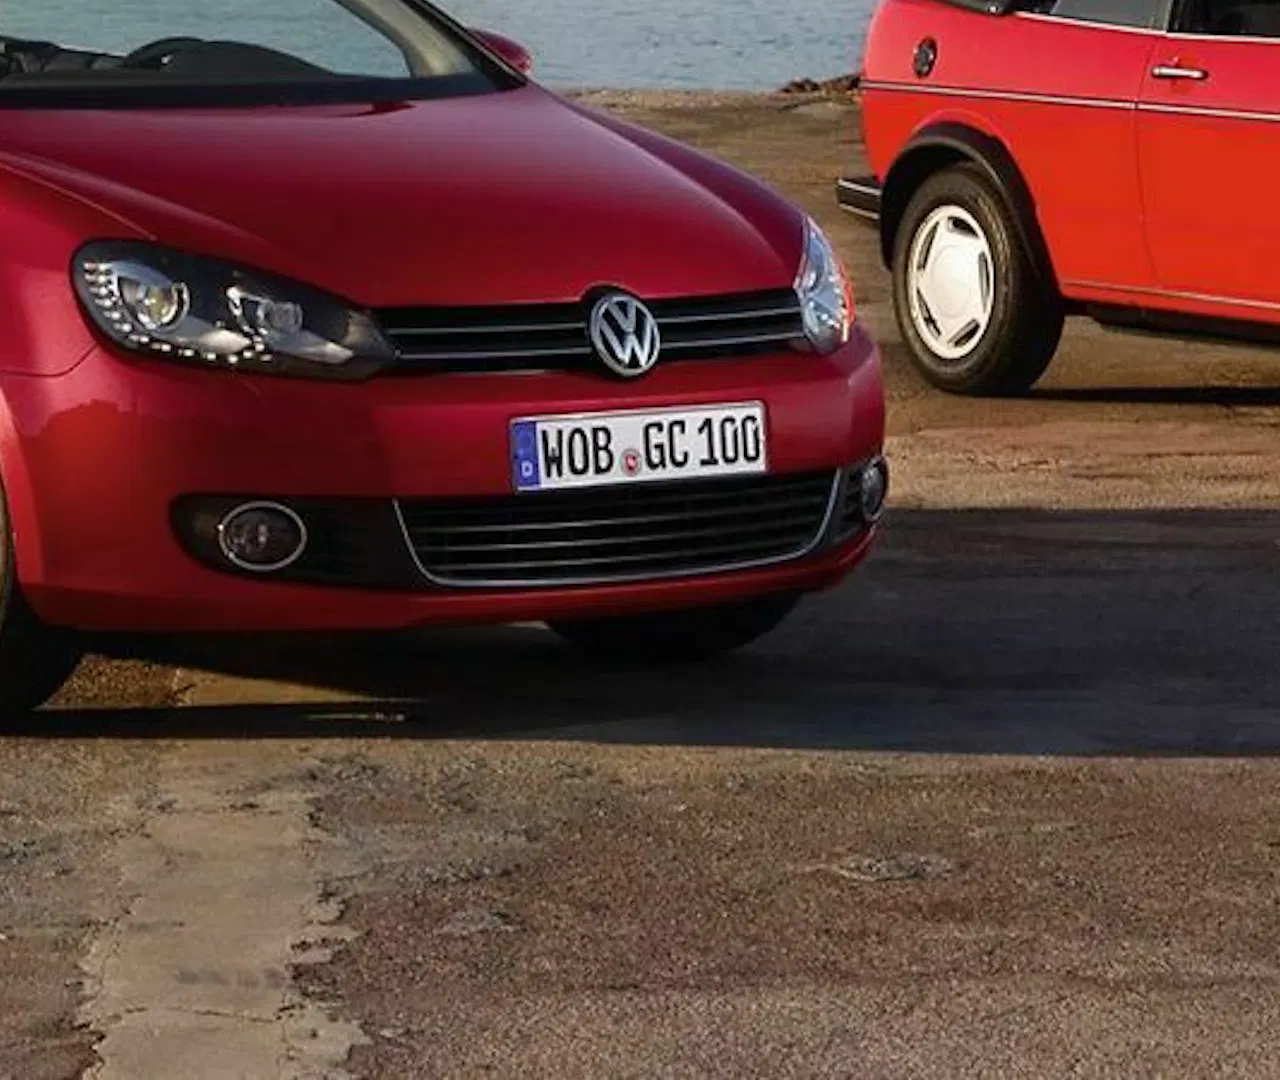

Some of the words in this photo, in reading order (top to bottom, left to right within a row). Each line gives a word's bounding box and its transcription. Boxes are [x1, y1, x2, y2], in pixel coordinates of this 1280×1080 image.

[593, 296, 659, 374] VW
[521, 461, 533, 477] D
[541, 427, 614, 478] WOB
[643, 420, 689, 470] GC
[697, 415, 761, 466] 100
